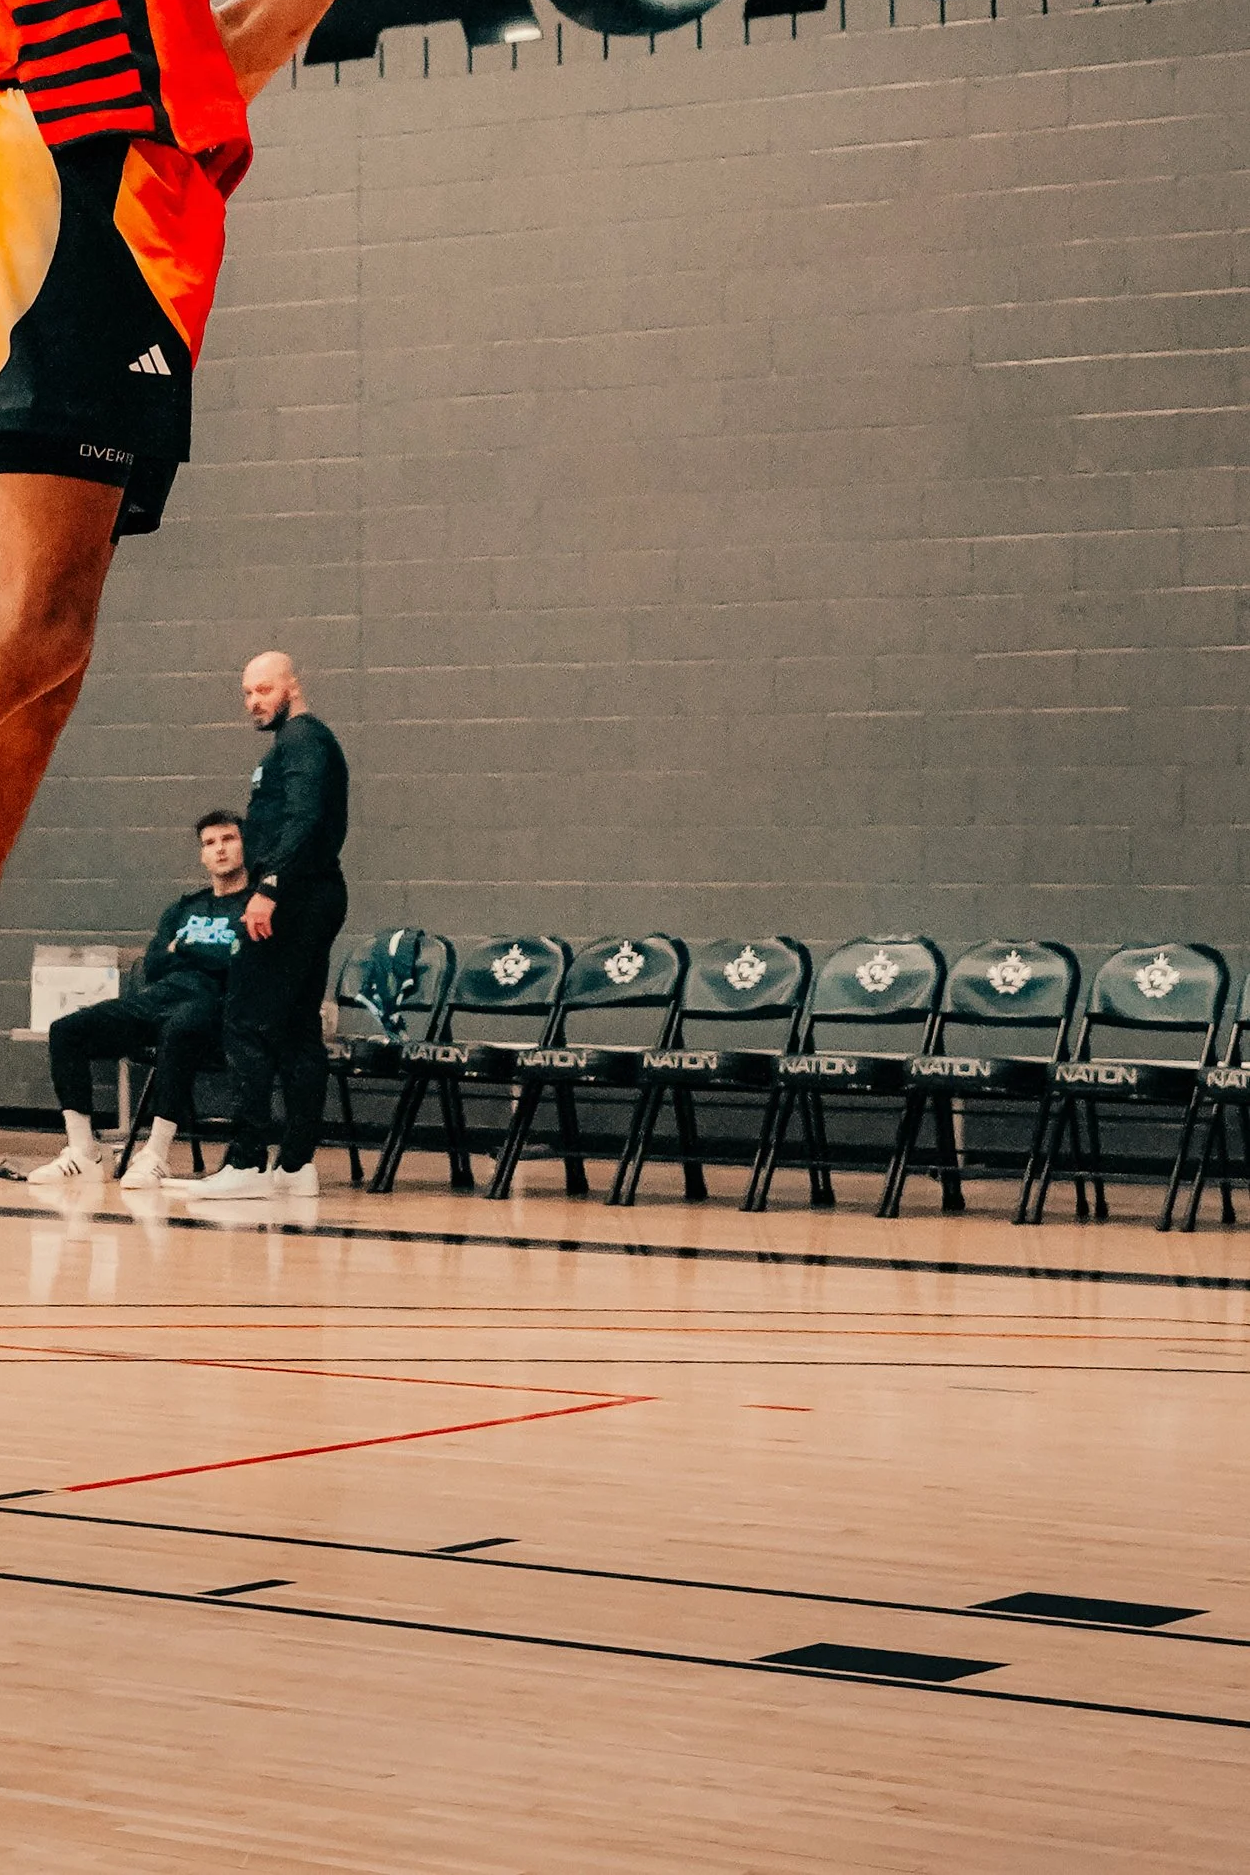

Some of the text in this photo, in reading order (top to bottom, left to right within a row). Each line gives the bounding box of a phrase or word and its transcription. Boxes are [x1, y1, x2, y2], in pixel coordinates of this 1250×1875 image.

[402, 1044, 468, 1065] NATION
[516, 1049, 587, 1068] NATION
[643, 1051, 717, 1070] NATION
[779, 1055, 856, 1075] NATION
[911, 1057, 990, 1077] NATION
[1056, 1063, 1137, 1085] NATION
